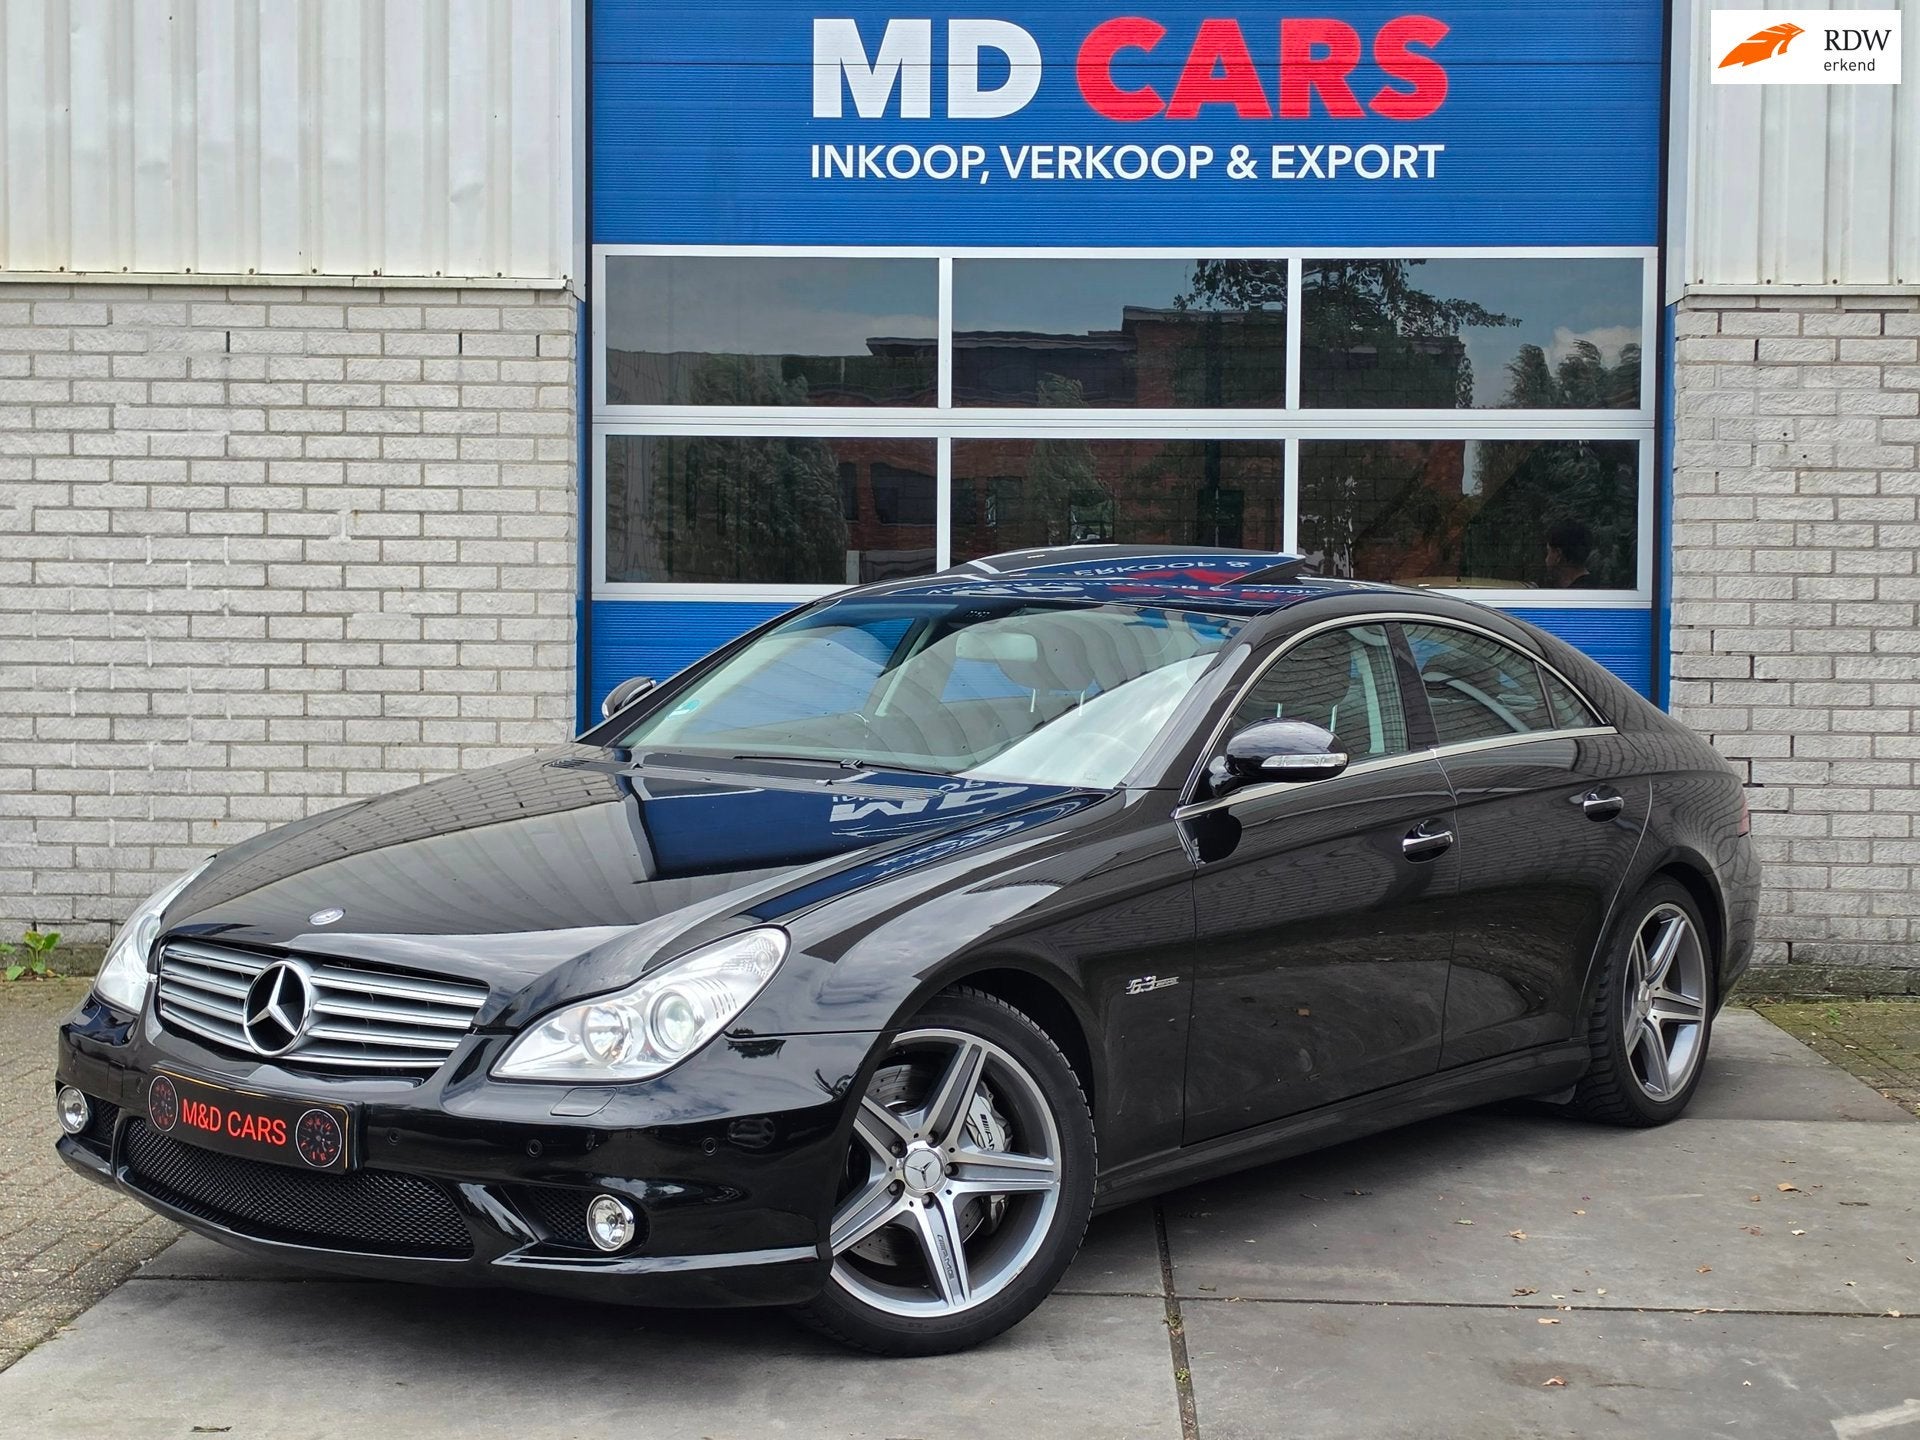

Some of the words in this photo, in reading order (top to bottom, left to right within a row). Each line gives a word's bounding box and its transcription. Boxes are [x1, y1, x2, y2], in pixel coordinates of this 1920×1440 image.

[812, 18, 1042, 119] MD
[1076, 15, 1450, 121] CARS
[811, 144, 990, 185] INKOOP,
[999, 144, 1214, 180] VERKOOP
[1226, 144, 1258, 180] &
[1271, 144, 1445, 179] EXPORT
[182, 1098, 223, 1132] M&D
[227, 1111, 287, 1146] CARS
